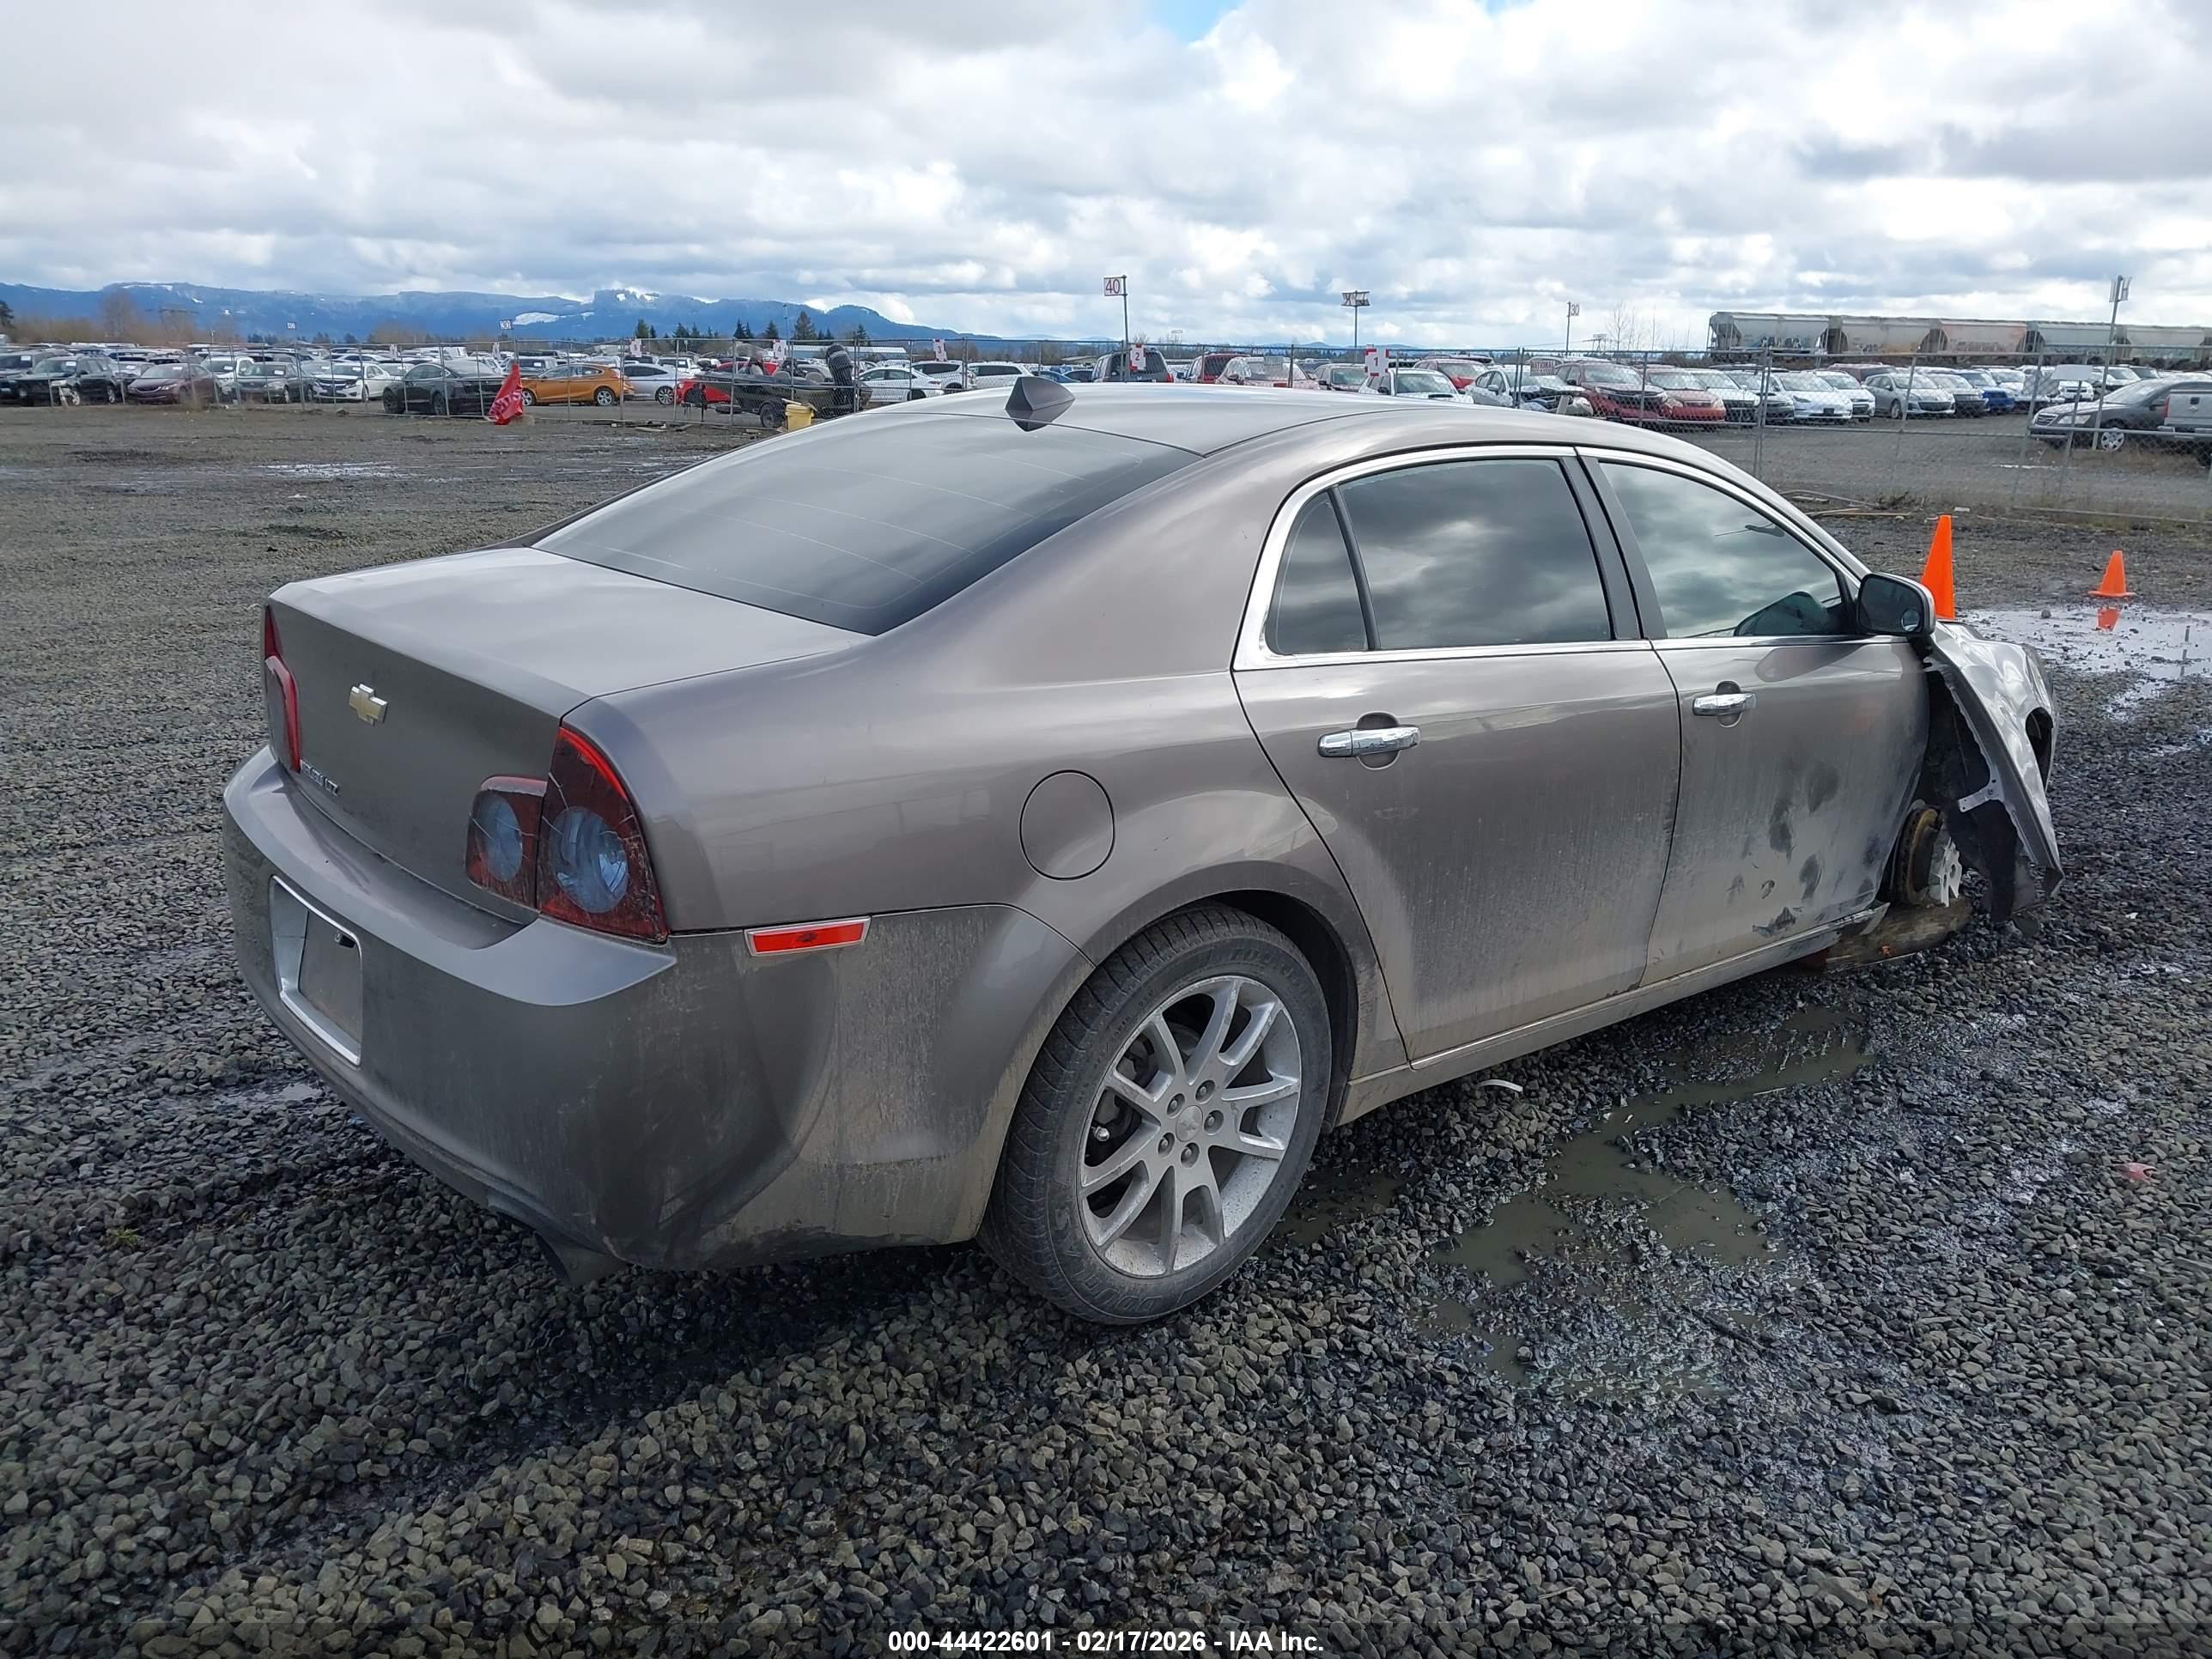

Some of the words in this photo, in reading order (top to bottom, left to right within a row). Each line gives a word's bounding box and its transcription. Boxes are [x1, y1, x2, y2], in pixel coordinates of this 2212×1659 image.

[1105, 279, 1121, 294] 40
[1135, 352, 1140, 362] 2
[1373, 356, 1378, 367] 1
